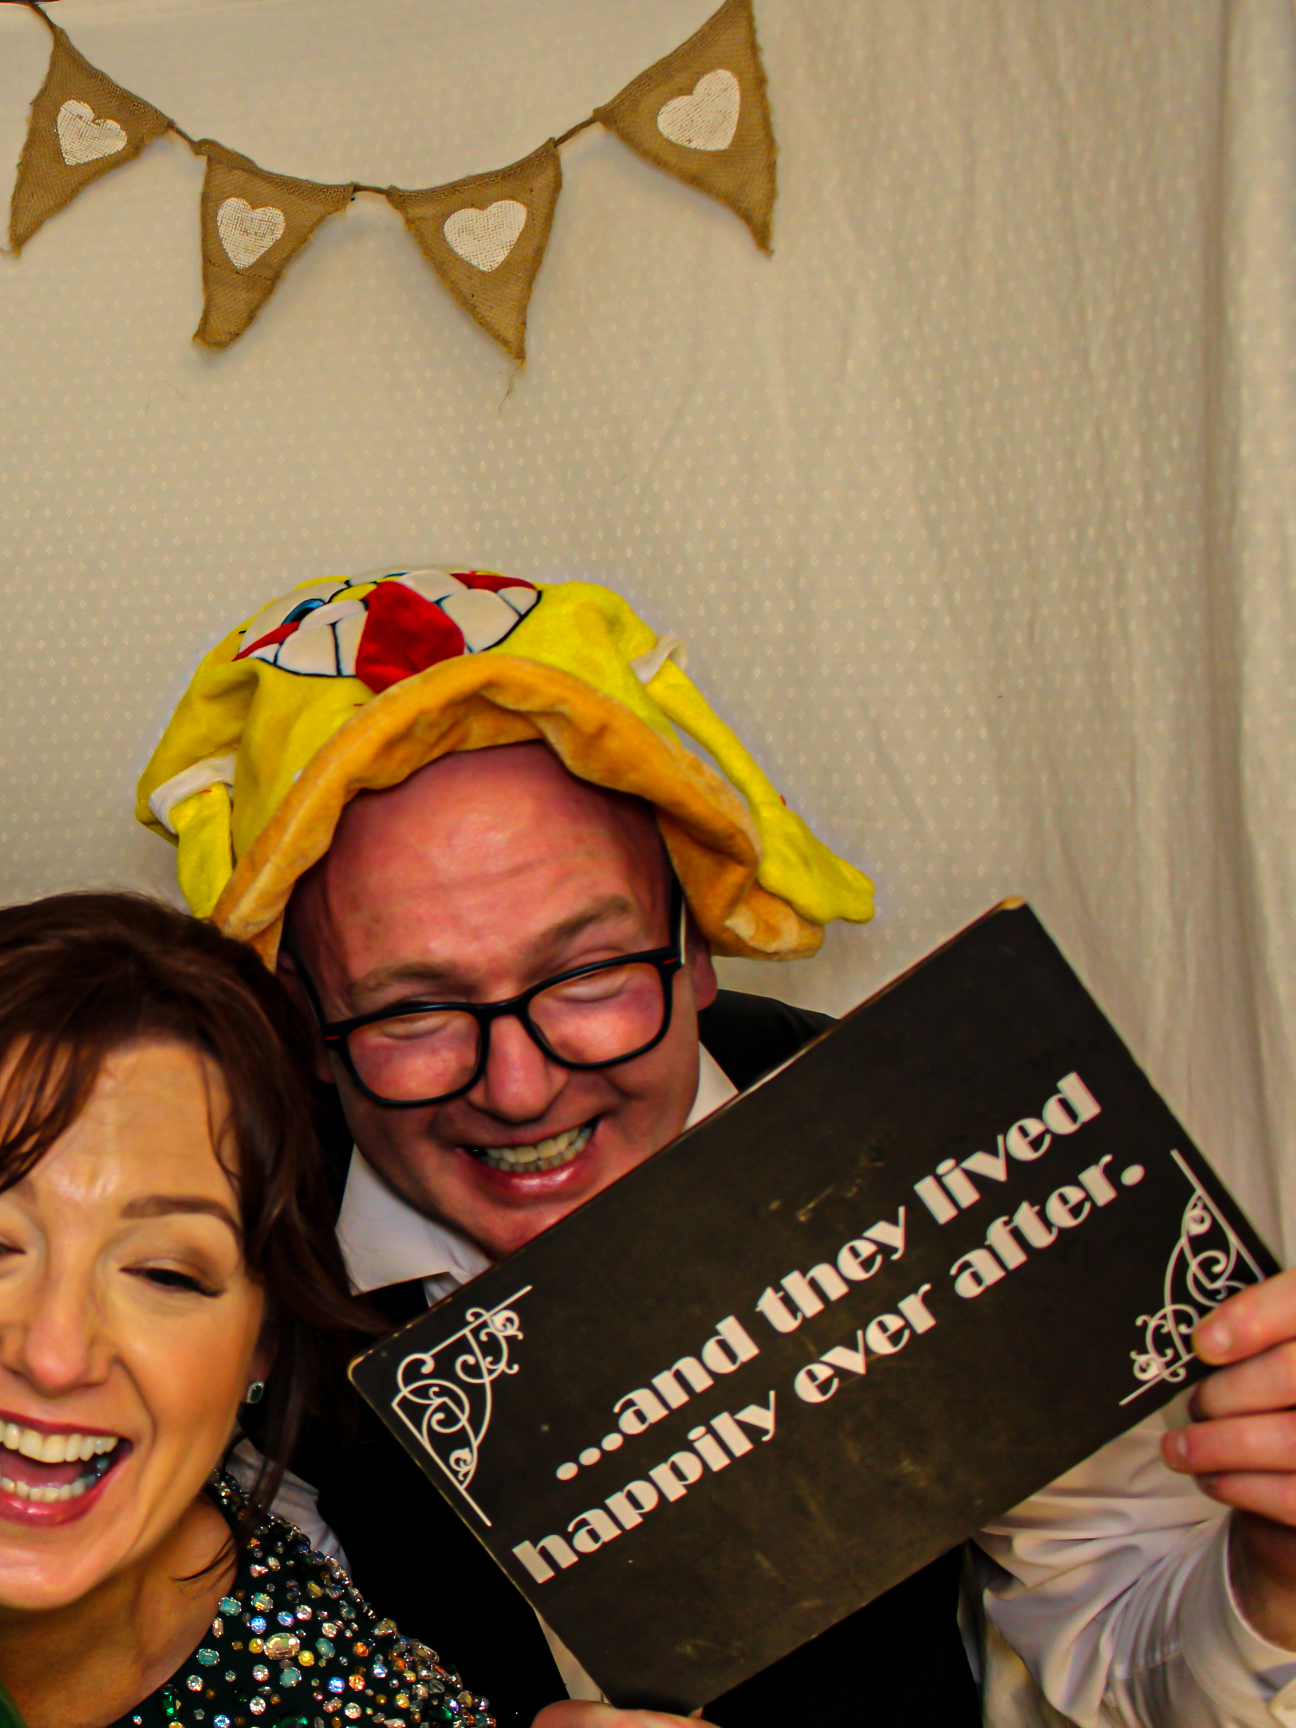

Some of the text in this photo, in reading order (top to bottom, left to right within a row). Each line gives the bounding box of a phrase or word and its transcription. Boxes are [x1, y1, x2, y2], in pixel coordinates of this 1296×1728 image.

[511, 1154, 1145, 1584] happily ever after.
[555, 1072, 1102, 1481] ...and they lived
